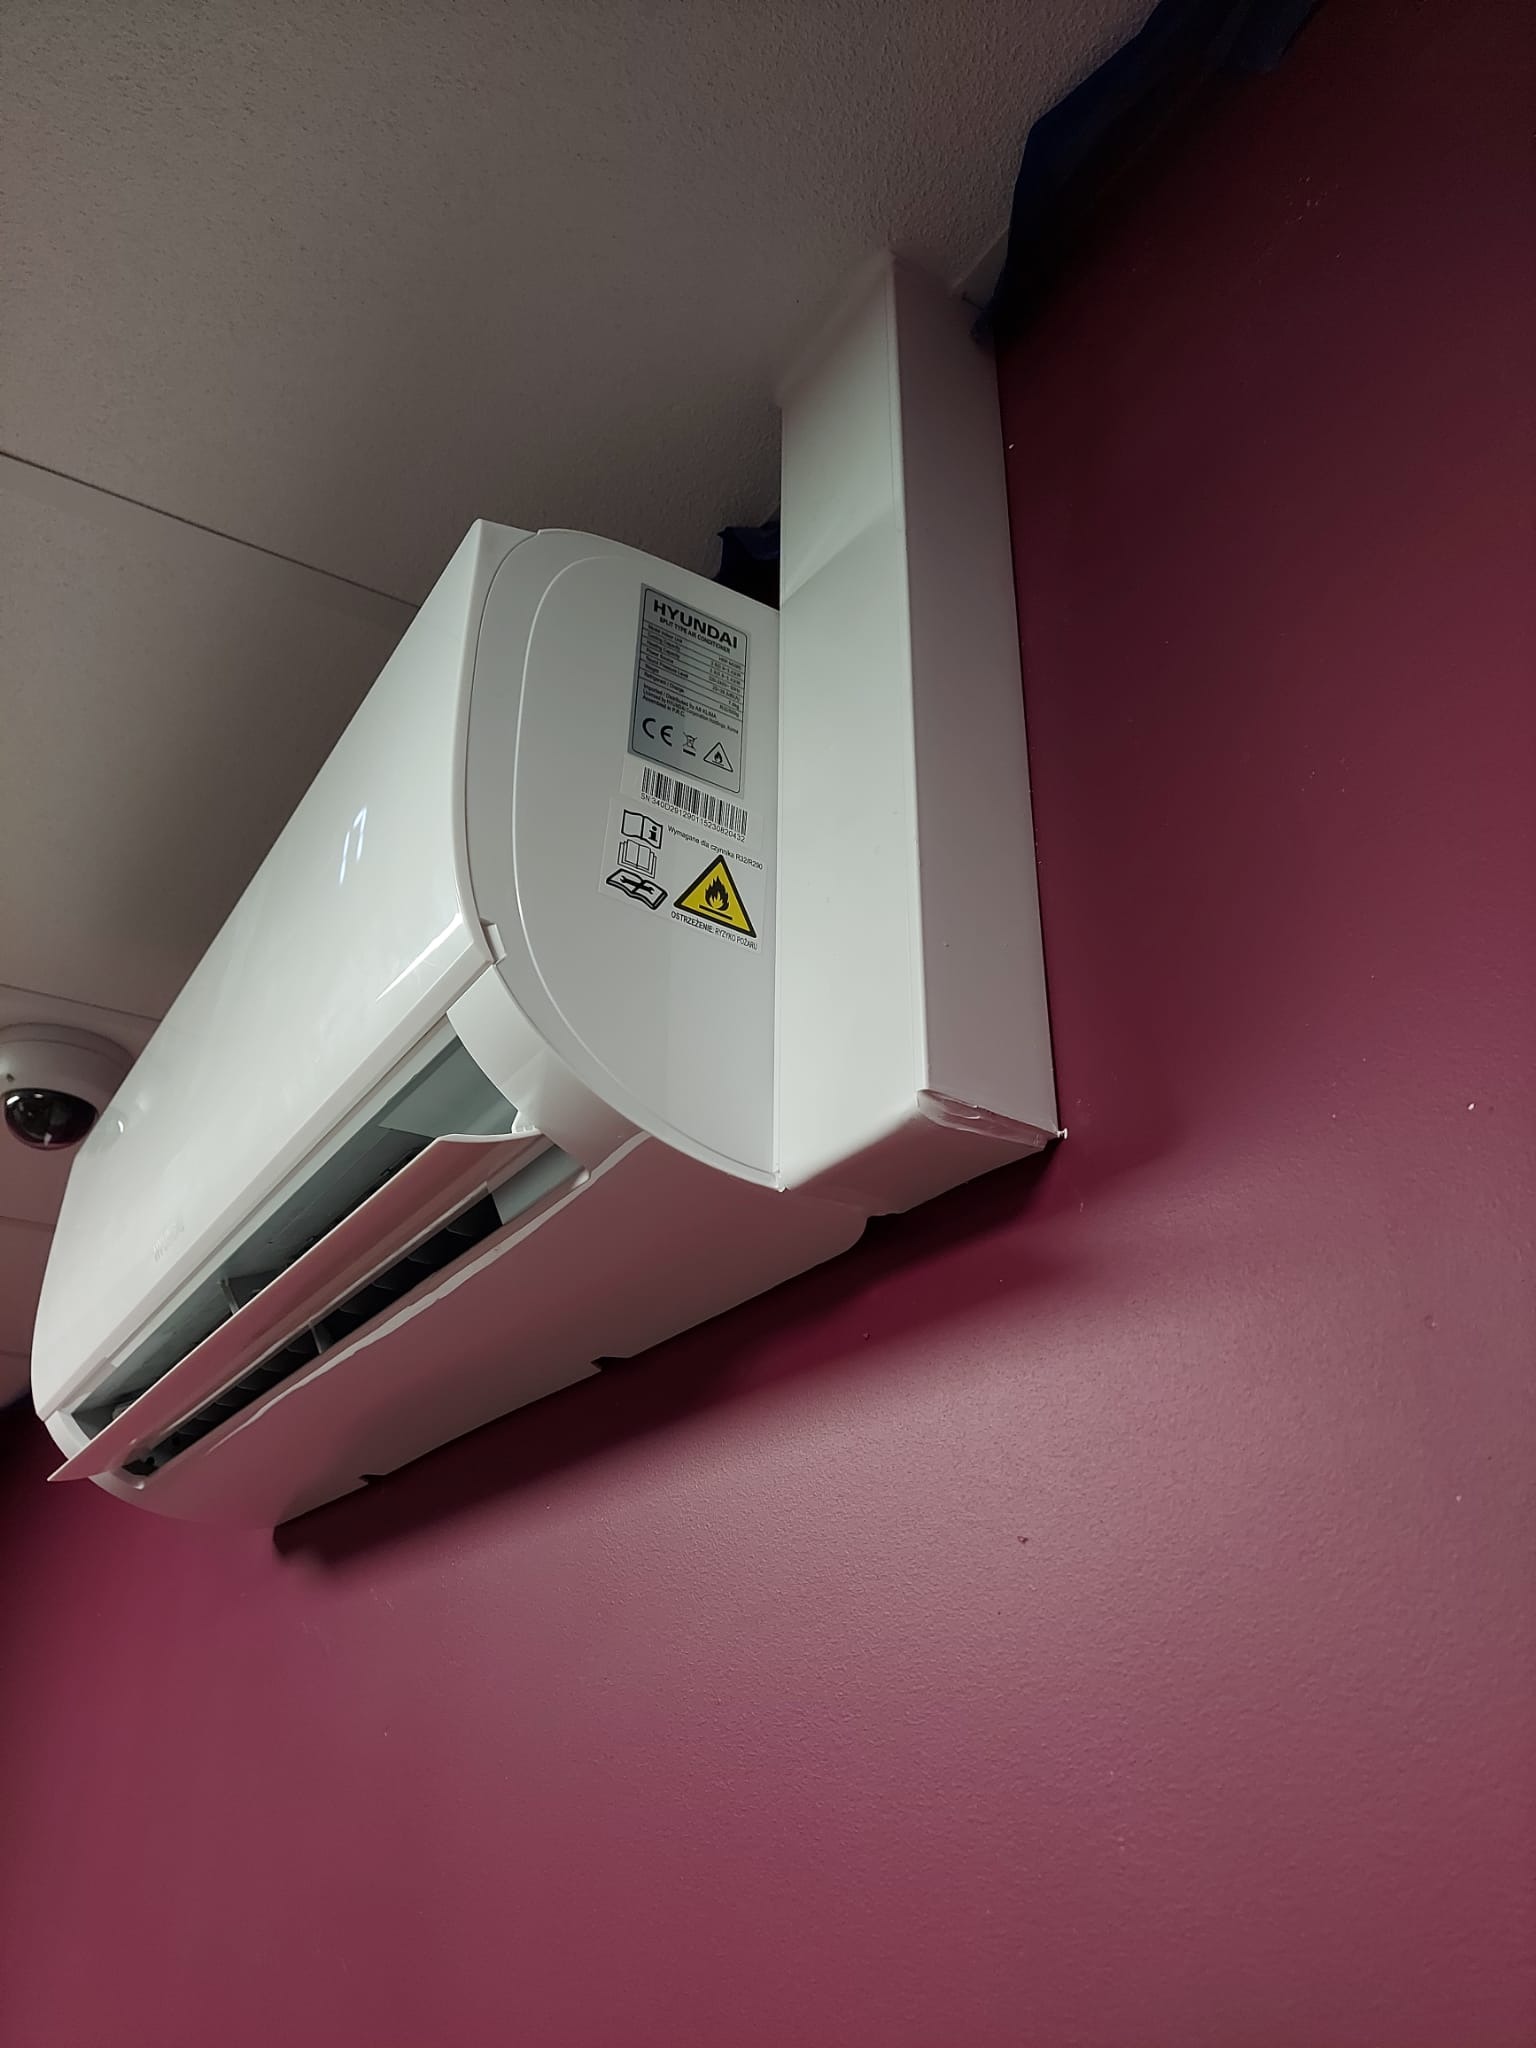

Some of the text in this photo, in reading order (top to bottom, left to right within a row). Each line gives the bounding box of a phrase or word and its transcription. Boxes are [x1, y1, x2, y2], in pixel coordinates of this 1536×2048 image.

[653, 599, 738, 649] HYUNDAI
[659, 616, 730, 654] SPLIT TYPE AIR CONDITIONER
[642, 718, 674, 747] CE
[667, 824, 700, 845] Wymagane
[700, 838, 710, 849] dla
[736, 853, 763, 870] R32/R290
[715, 928, 736, 942] RYZYKO
